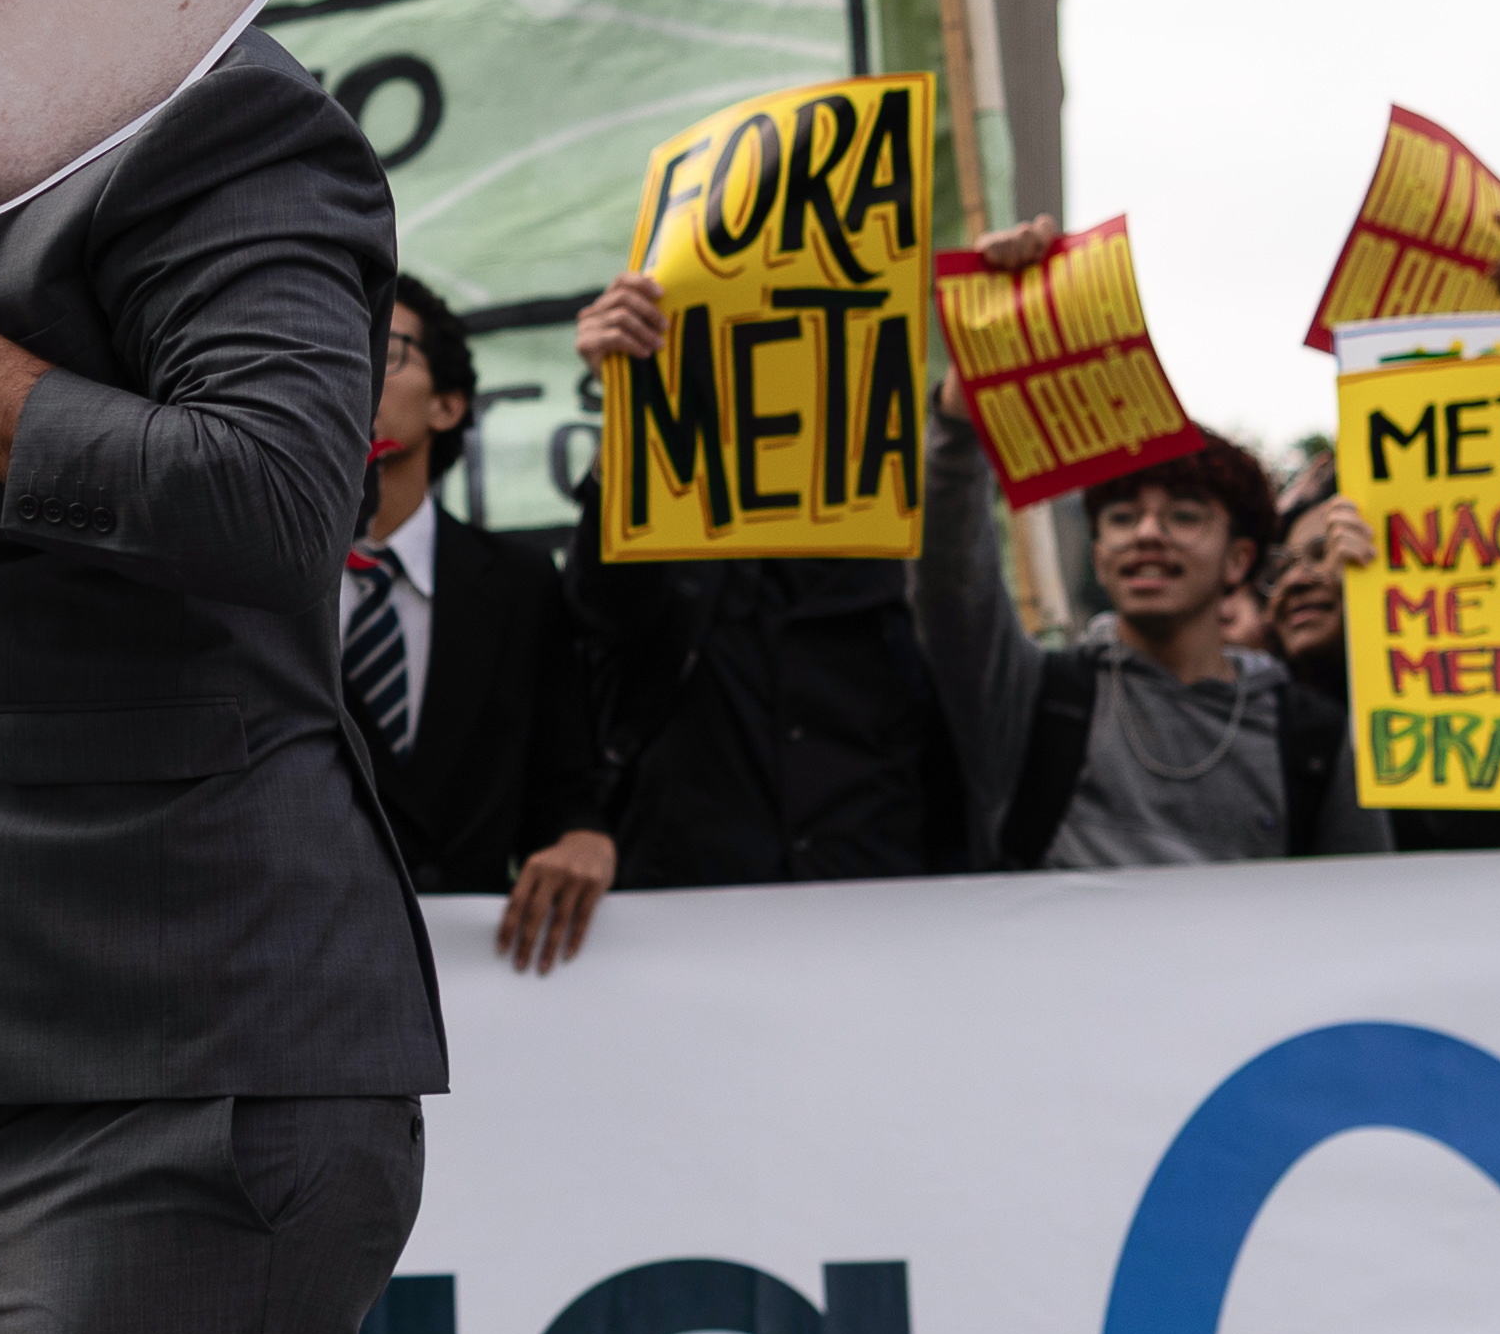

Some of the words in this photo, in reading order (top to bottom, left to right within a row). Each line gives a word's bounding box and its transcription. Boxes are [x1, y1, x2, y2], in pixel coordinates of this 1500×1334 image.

[641, 88, 917, 284] FORA
[1048, 231, 1146, 354] MÃO
[625, 288, 919, 532] META
[974, 380, 1058, 484] DA
[1025, 346, 1187, 468] ELEIÇÃO
[1384, 576, 1496, 637] ME
